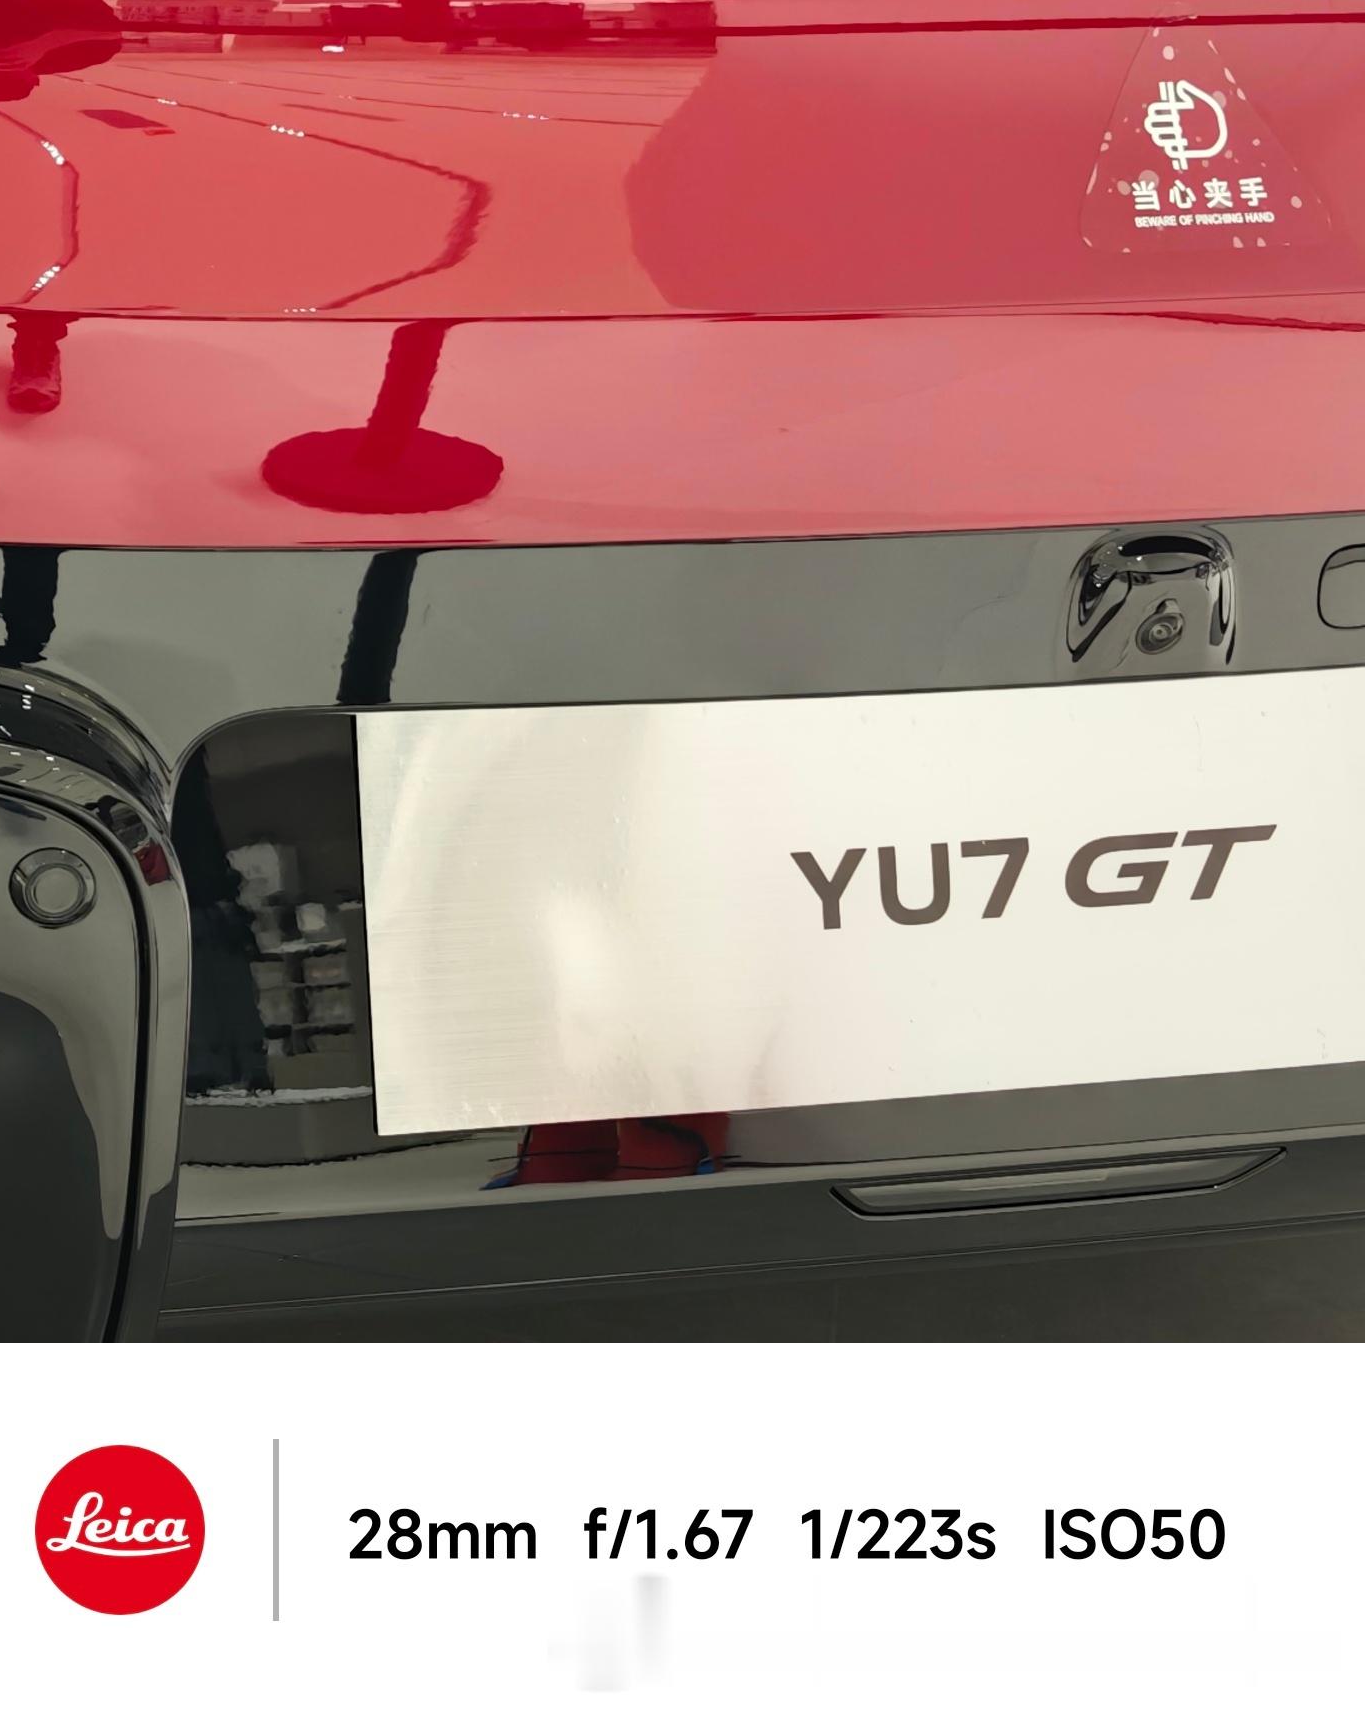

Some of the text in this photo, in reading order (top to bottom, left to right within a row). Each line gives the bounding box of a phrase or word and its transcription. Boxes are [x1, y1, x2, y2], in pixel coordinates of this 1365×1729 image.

[1132, 176, 1267, 211] 当心夹手
[1135, 211, 1275, 228] BEWARE OF PINCHING HAND
[790, 824, 1277, 931] YU7 GT
